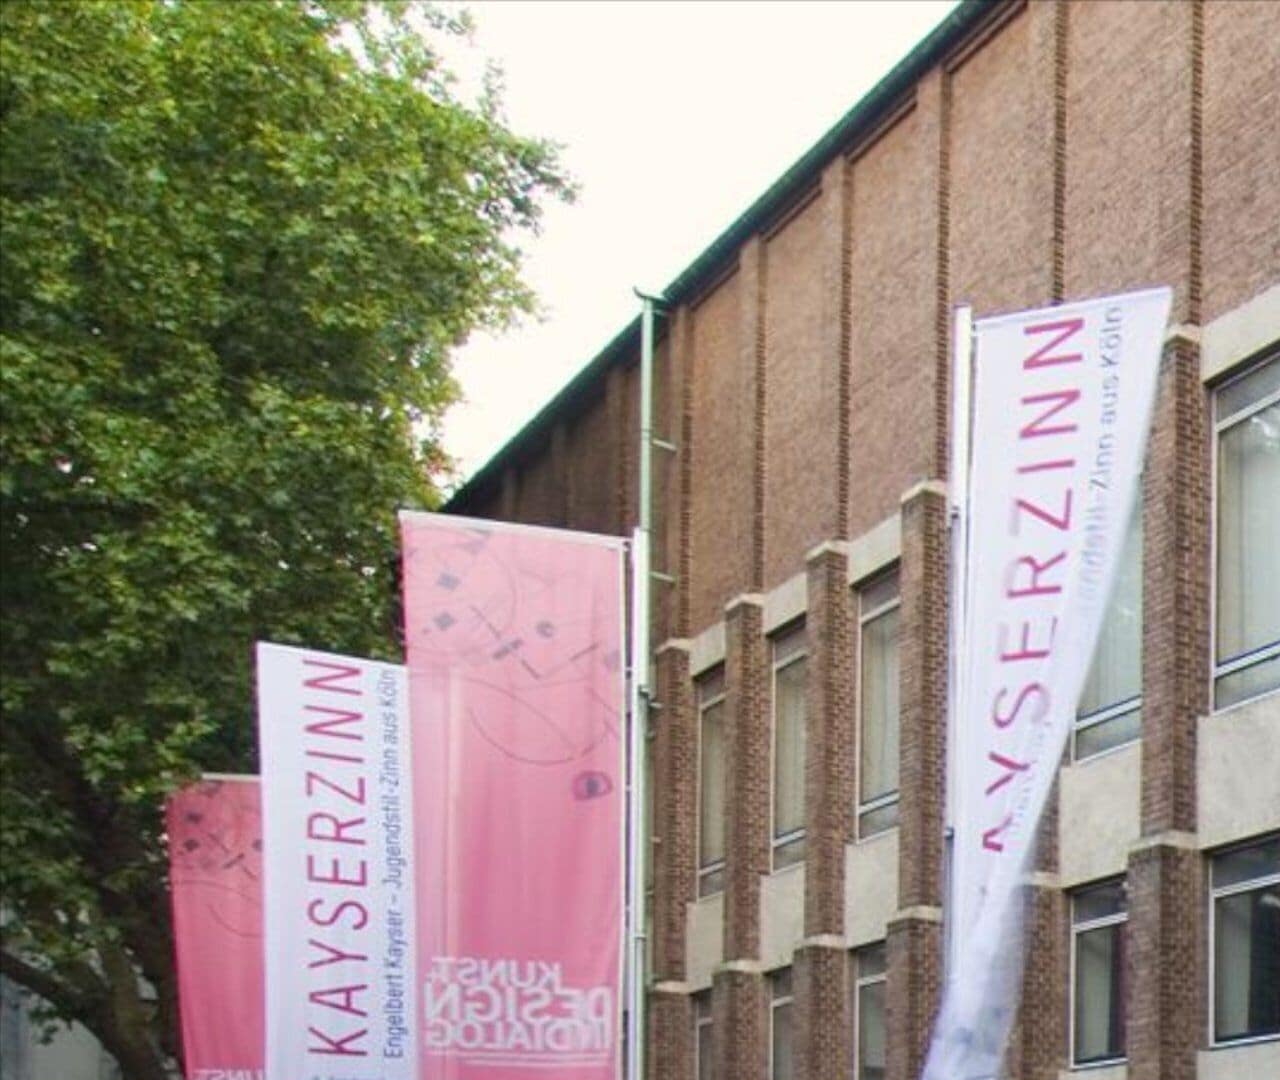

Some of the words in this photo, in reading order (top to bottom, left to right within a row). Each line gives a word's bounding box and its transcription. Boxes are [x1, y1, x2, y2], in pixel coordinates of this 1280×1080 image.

[1096, 305, 1123, 367] Köln
[381, 711, 397, 744] aus
[301, 658, 369, 1057] KAYSERZINN
[382, 909, 408, 969] Kayser
[382, 975, 407, 1059] Engelbert
